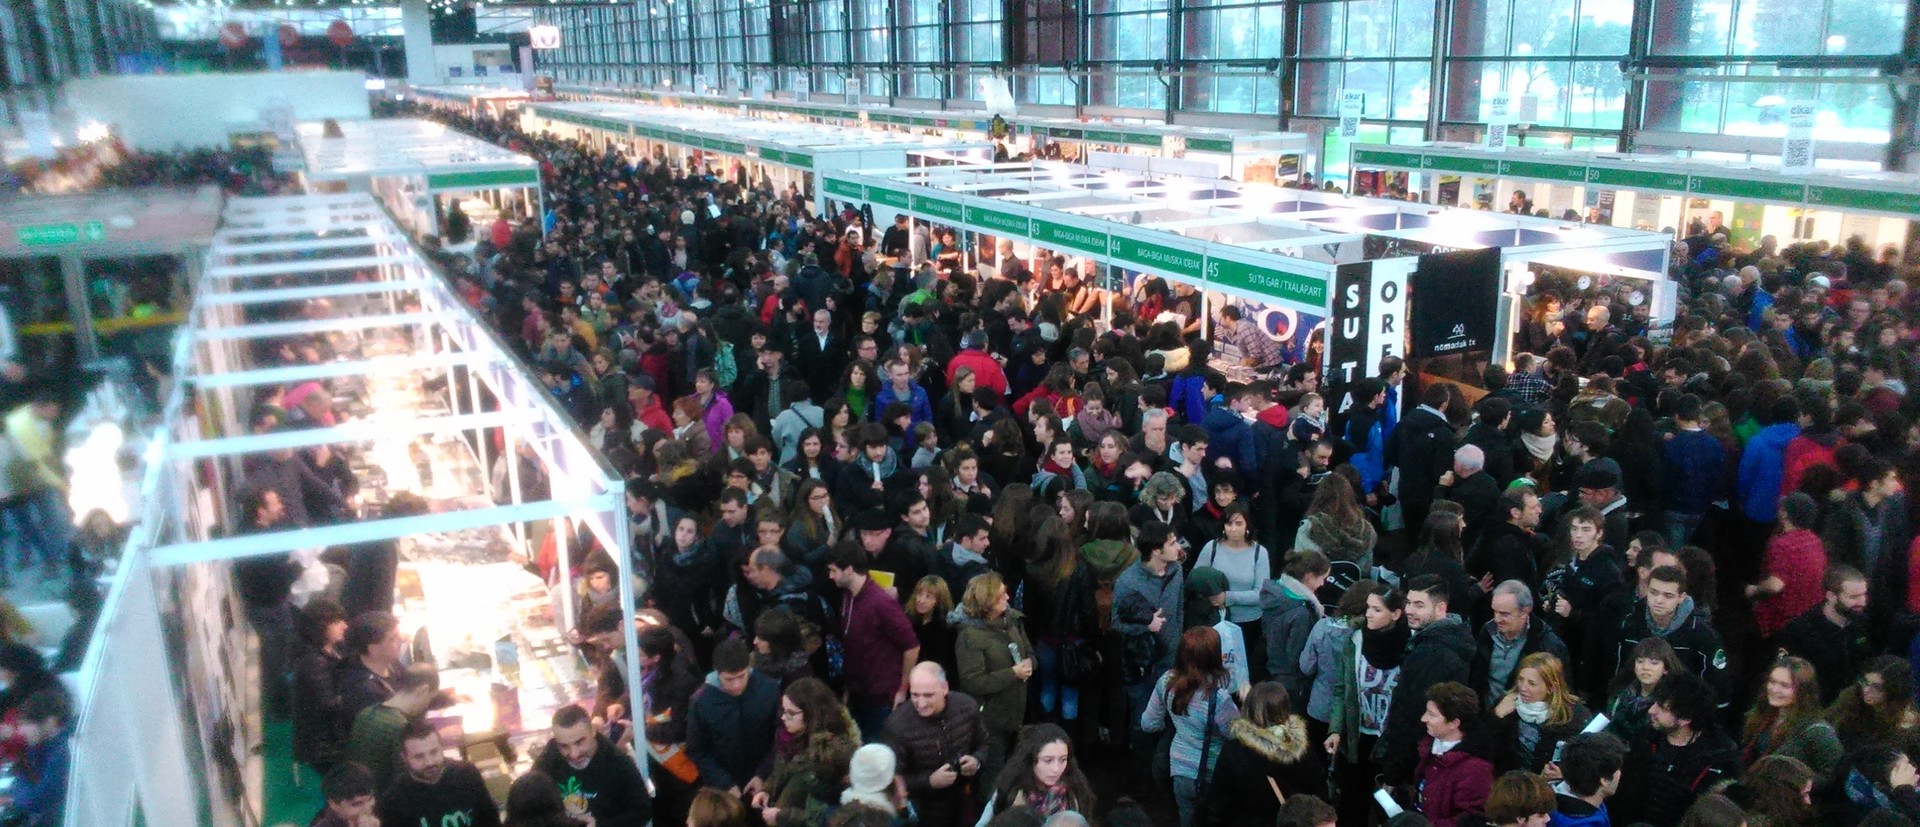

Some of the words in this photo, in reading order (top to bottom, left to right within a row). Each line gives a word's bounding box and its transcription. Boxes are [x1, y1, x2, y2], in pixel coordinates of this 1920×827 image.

[1492, 97, 1509, 106] elkar
[1790, 105, 1815, 116] elkar
[1589, 169, 1600, 180] 50
[1690, 178, 1702, 190] 51
[966, 208, 973, 221] 42
[1032, 222, 1040, 236] 43
[1111, 239, 1121, 254] 44
[1137, 248, 1163, 262] BAGA-BIGA
[1163, 253, 1183, 267] MUSIKA
[1183, 258, 1200, 271] IDEIAK
[1207, 262, 1219, 278] 45
[1248, 273, 1257, 284] SU
[1257, 275, 1266, 286] TA
[1433, 339, 1467, 352] nomadak
[1468, 338, 1477, 347] tx
